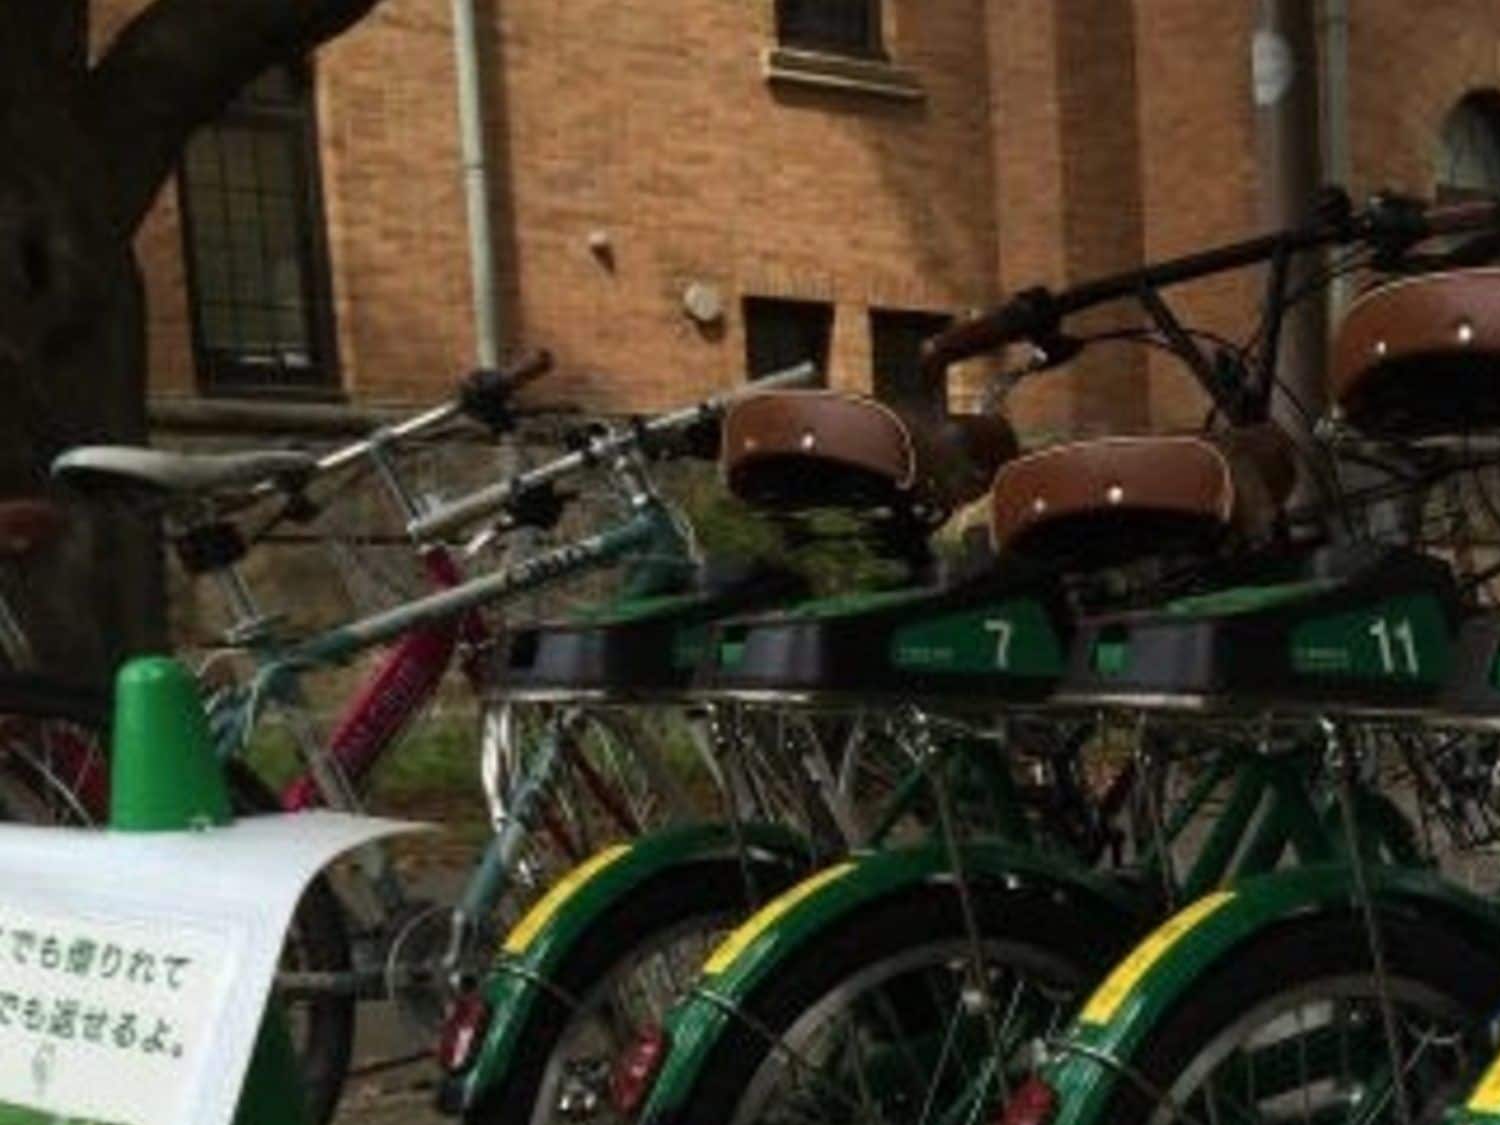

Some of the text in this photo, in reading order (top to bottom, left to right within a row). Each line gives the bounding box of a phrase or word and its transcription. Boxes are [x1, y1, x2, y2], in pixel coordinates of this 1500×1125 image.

[983, 618, 1013, 669] 7
[1369, 618, 1420, 675] 11
[0, 926, 193, 990] でも借りれて
